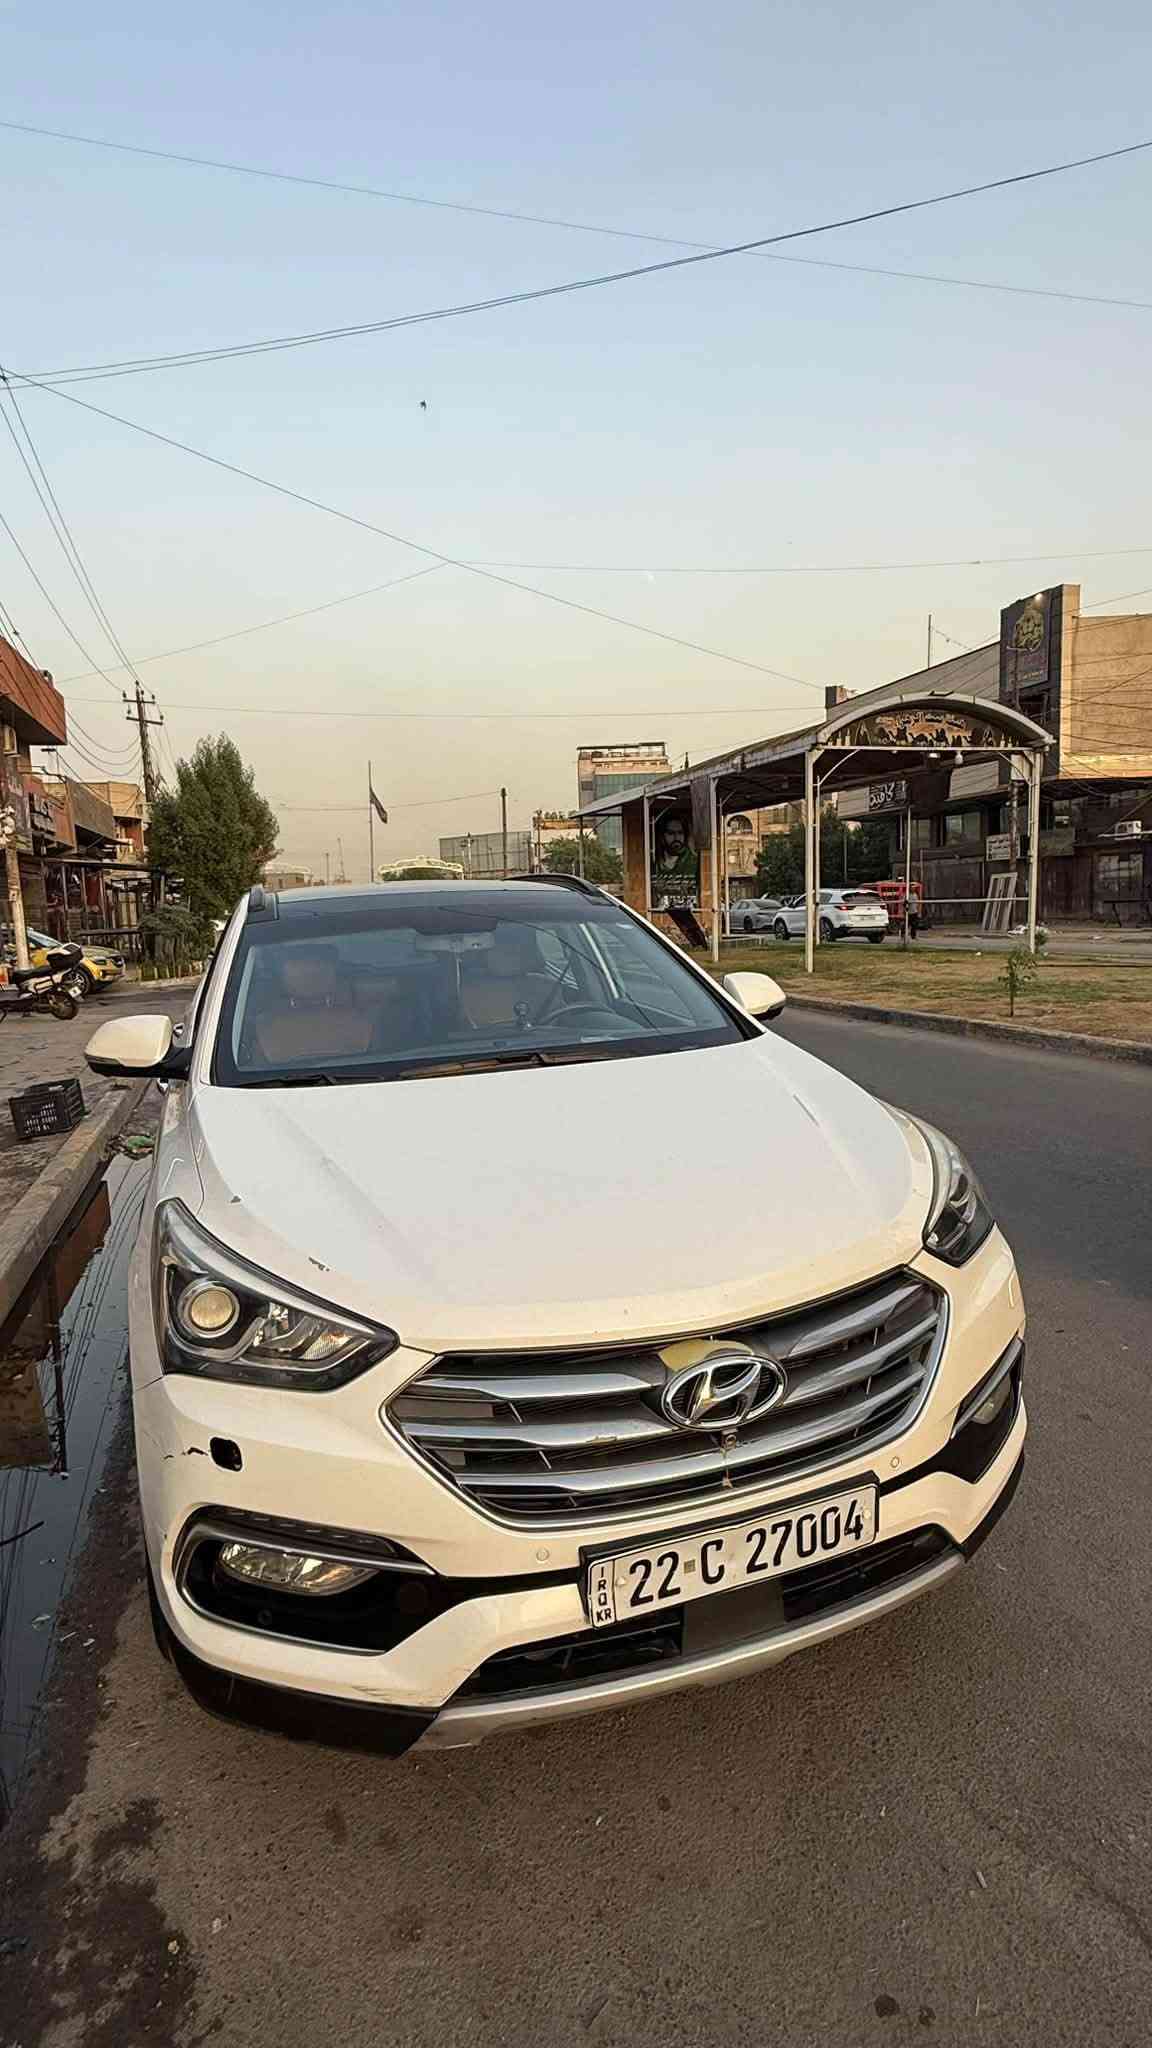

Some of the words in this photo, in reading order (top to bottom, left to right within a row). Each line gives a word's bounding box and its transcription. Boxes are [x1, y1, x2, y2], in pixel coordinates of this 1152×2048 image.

[630, 1551, 682, 1607] 22
[701, 1539, 725, 1585] C
[745, 1500, 863, 1574] 27004
